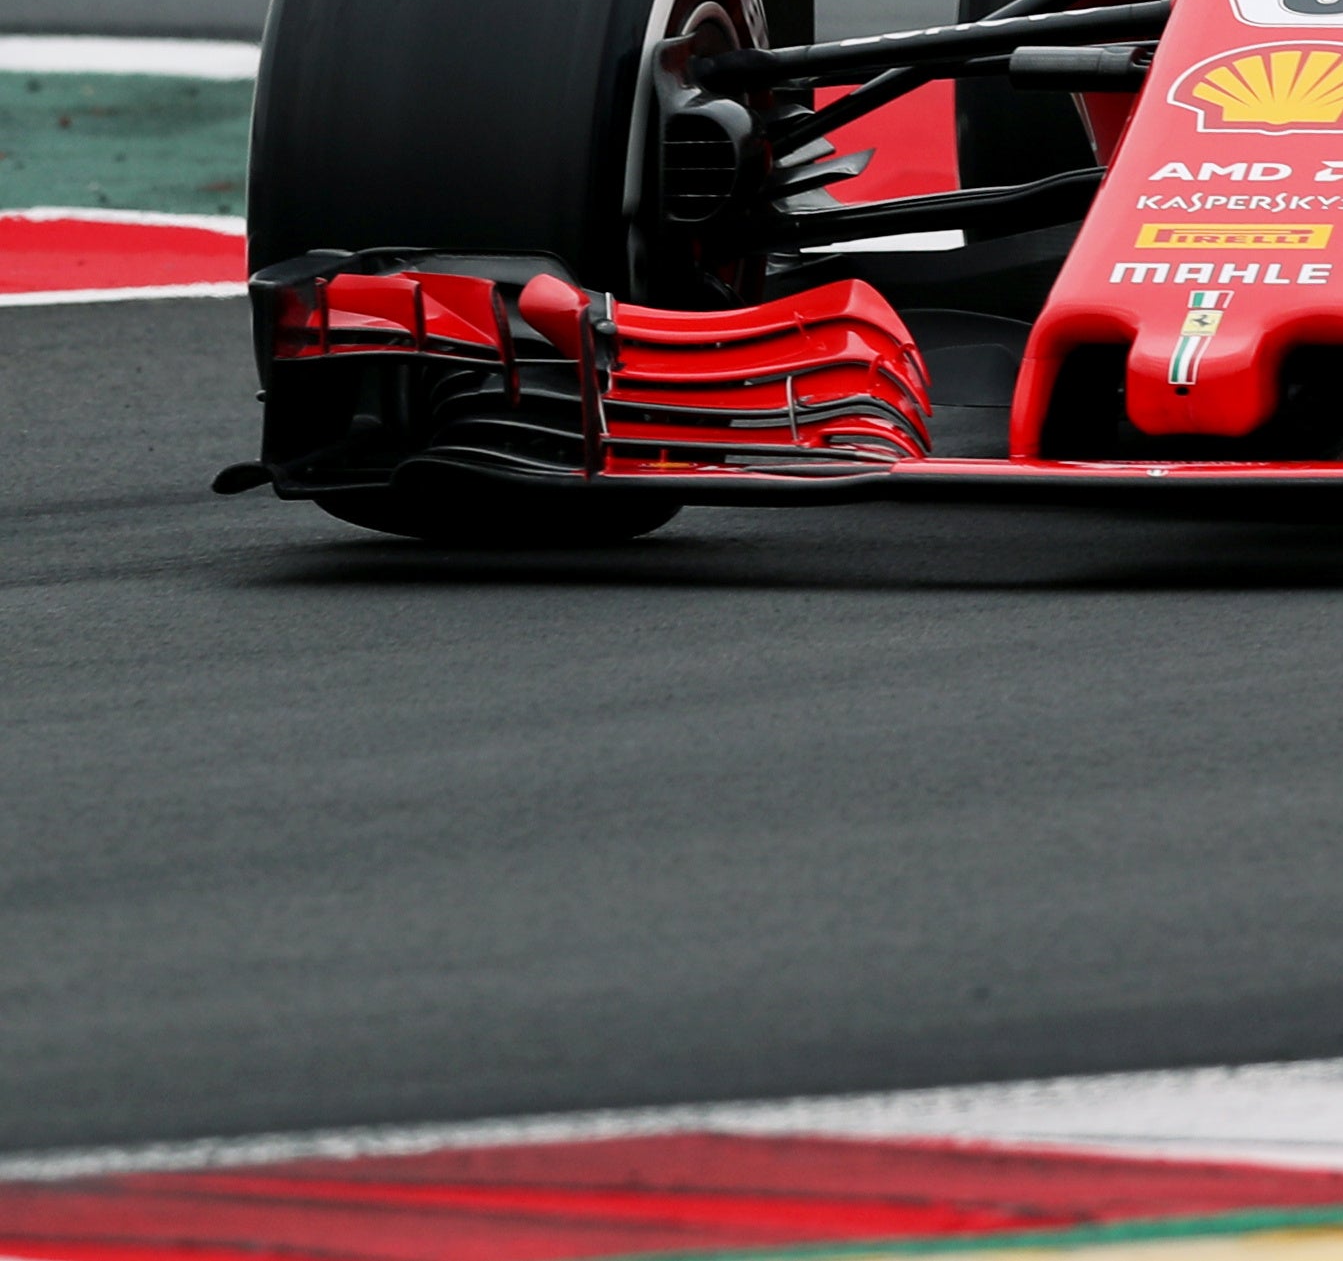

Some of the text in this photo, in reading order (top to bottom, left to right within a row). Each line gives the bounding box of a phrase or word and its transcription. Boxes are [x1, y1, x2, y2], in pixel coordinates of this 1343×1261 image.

[1147, 161, 1294, 182] AMD
[1136, 192, 1340, 212] KASPERSKY
[1153, 227, 1315, 245] PIRELLI
[1109, 262, 1333, 284] MAHLE
